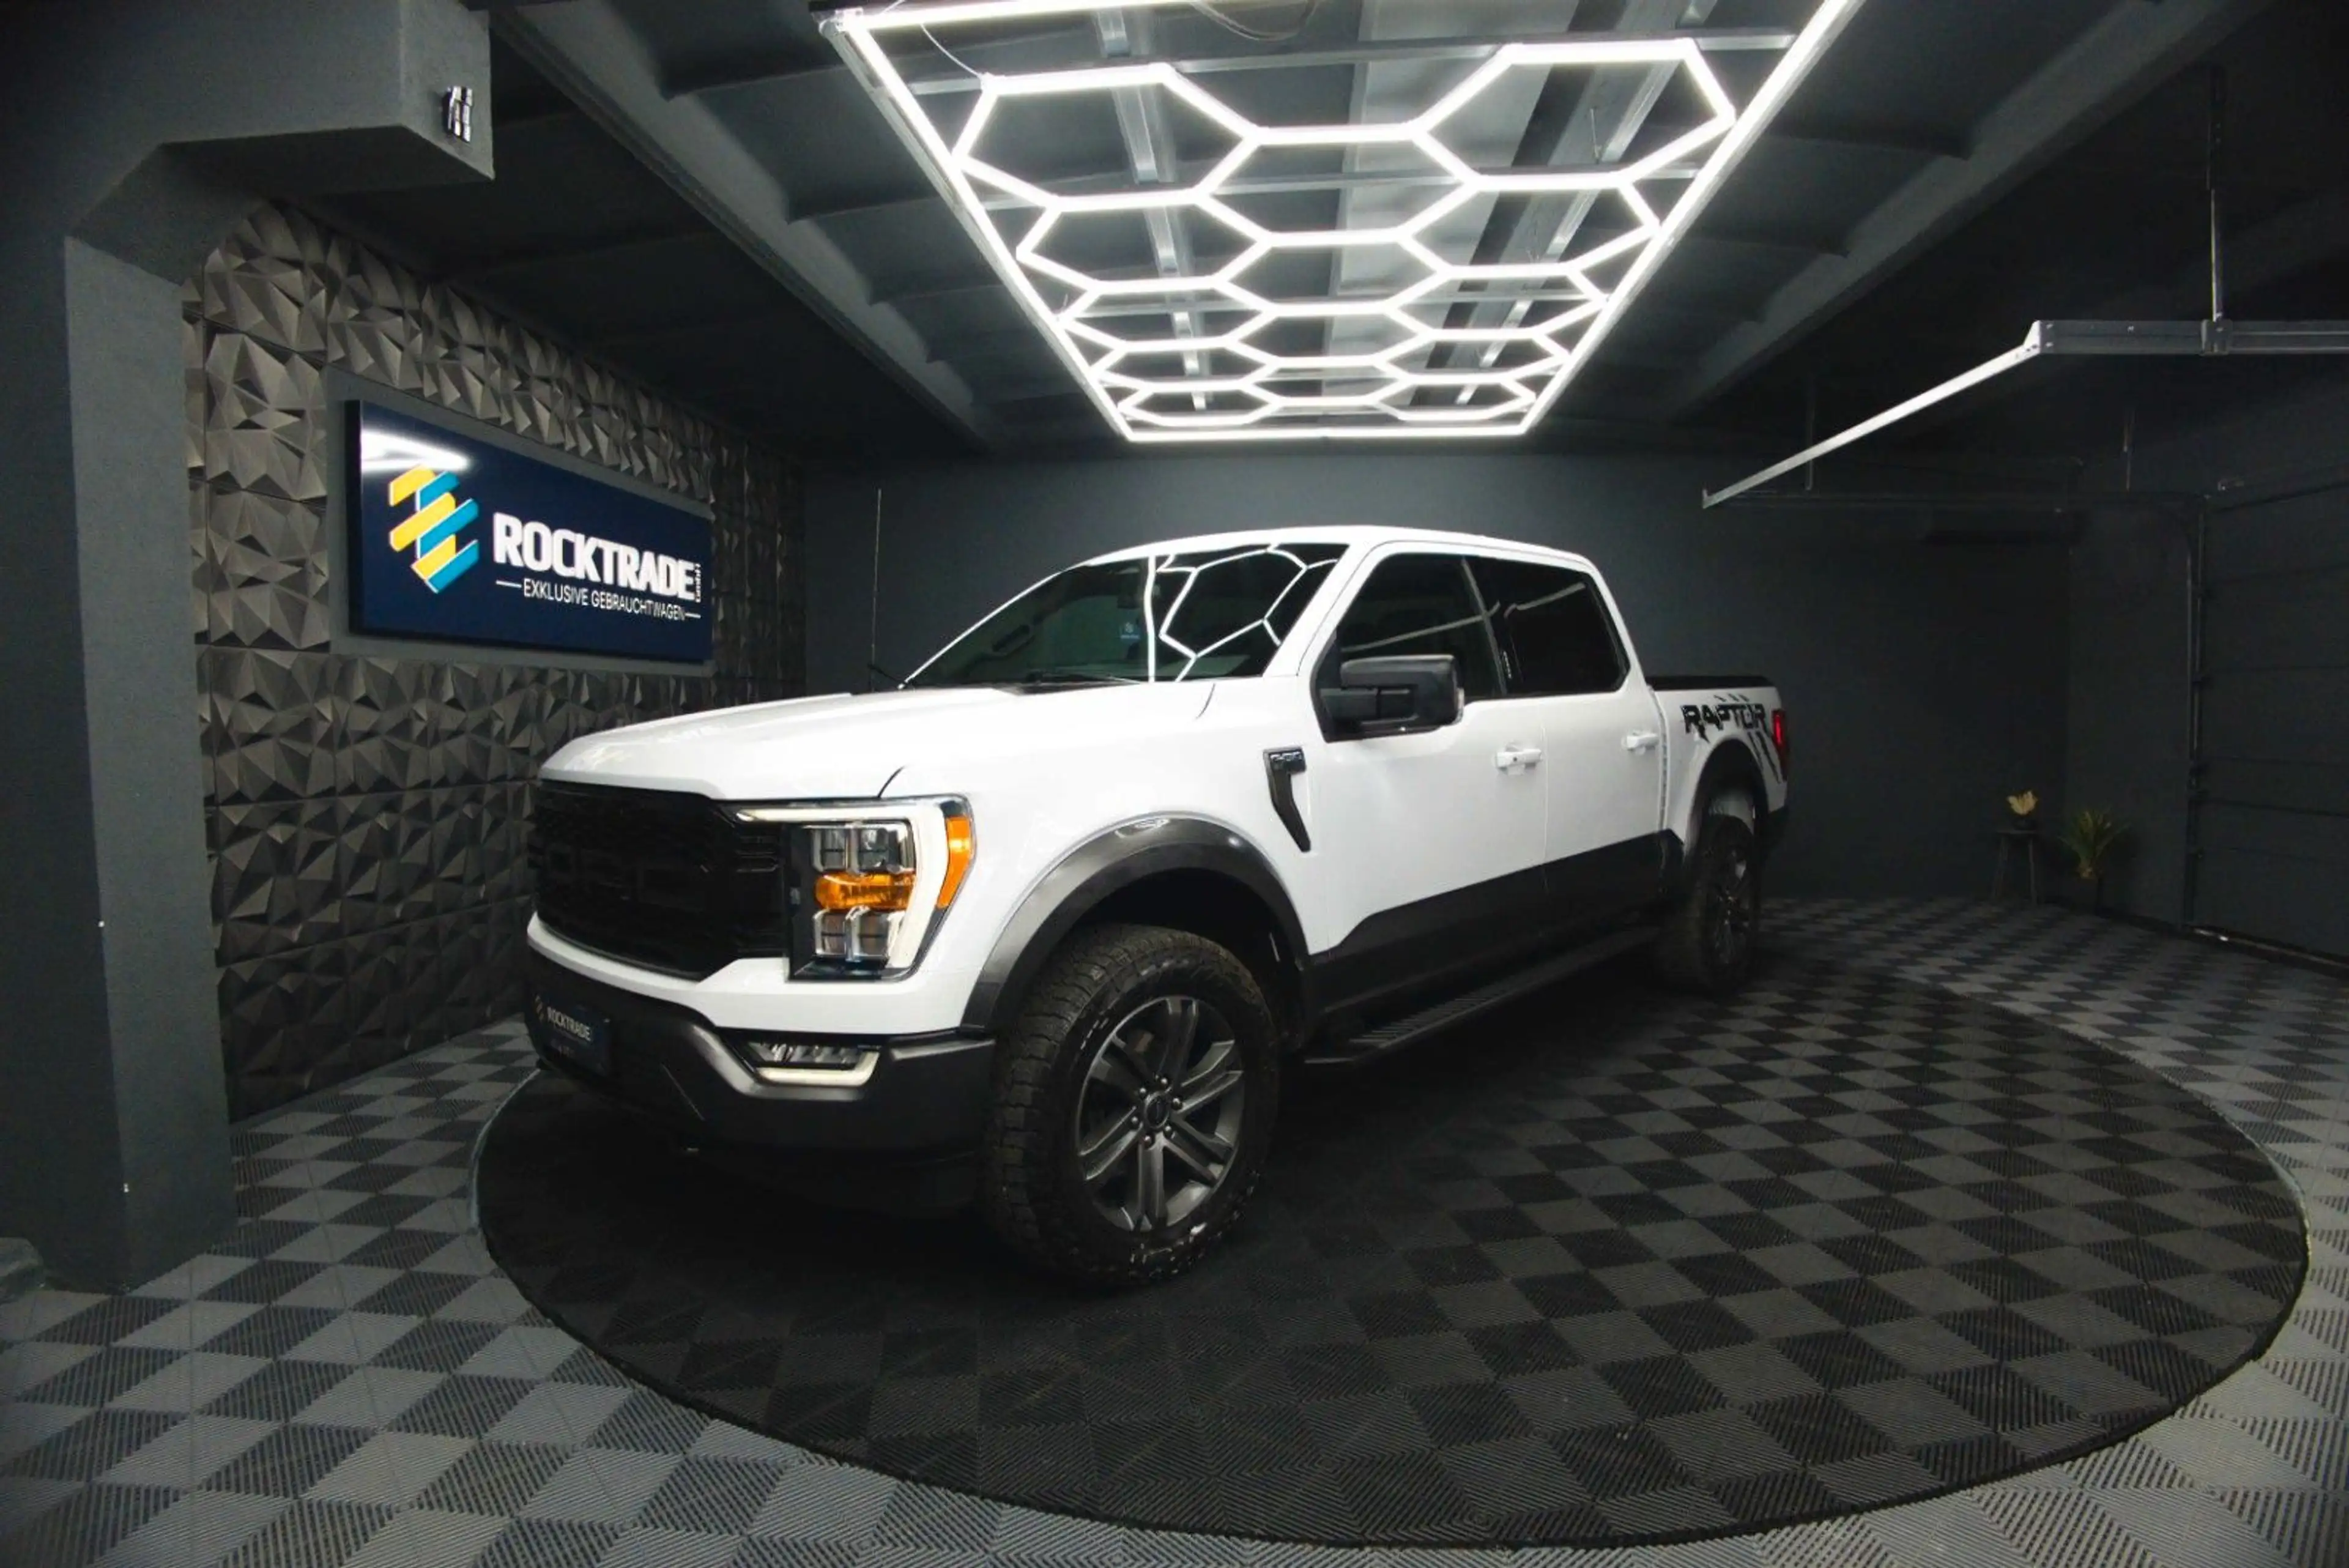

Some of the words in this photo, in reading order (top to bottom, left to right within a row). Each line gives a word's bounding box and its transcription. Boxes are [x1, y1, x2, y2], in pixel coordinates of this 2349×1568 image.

[493, 512, 694, 600] ROCKTRADE
[524, 578, 588, 606] EXKLUSIVE
[591, 590, 686, 622] GEBRAUCHTWAGEN
[1681, 704, 1770, 743] RAPTOR
